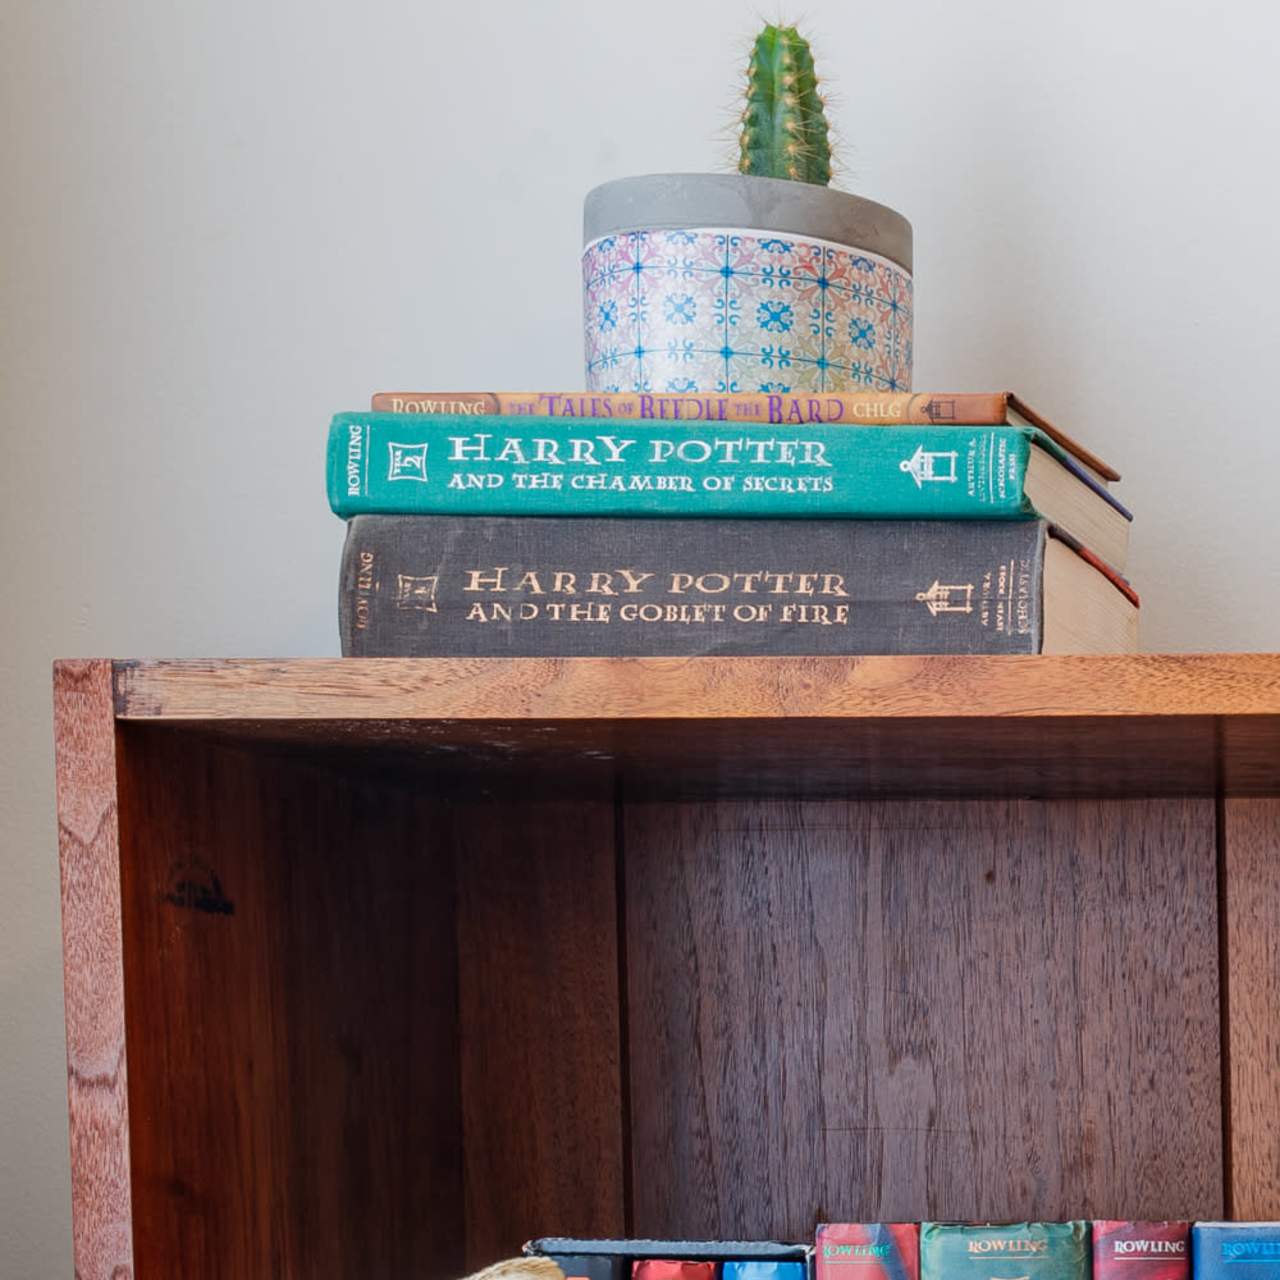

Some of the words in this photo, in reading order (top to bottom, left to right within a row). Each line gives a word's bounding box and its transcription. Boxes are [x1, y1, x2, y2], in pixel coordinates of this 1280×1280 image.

[768, 395, 843, 424] BARD
[853, 402, 900, 418] CHLG
[348, 425, 362, 496] ROWLING
[447, 434, 636, 466] HARRY
[648, 438, 833, 467] POTTER
[447, 473, 503, 490] AND
[512, 473, 564, 490] THE
[571, 474, 696, 492] CHAMBER
[703, 475, 737, 492] OF
[743, 474, 833, 493] SECRETS
[463, 567, 655, 596] HARRY
[667, 571, 850, 597] POTTER
[465, 603, 538, 624] AND
[546, 603, 611, 624] THE
[620, 604, 725, 625] GOBLET
[733, 604, 774, 623] OF
[779, 604, 849, 625] FIRE
[968, 1239, 1048, 1253] ROWLING
[1115, 1240, 1185, 1253] ROWLING
